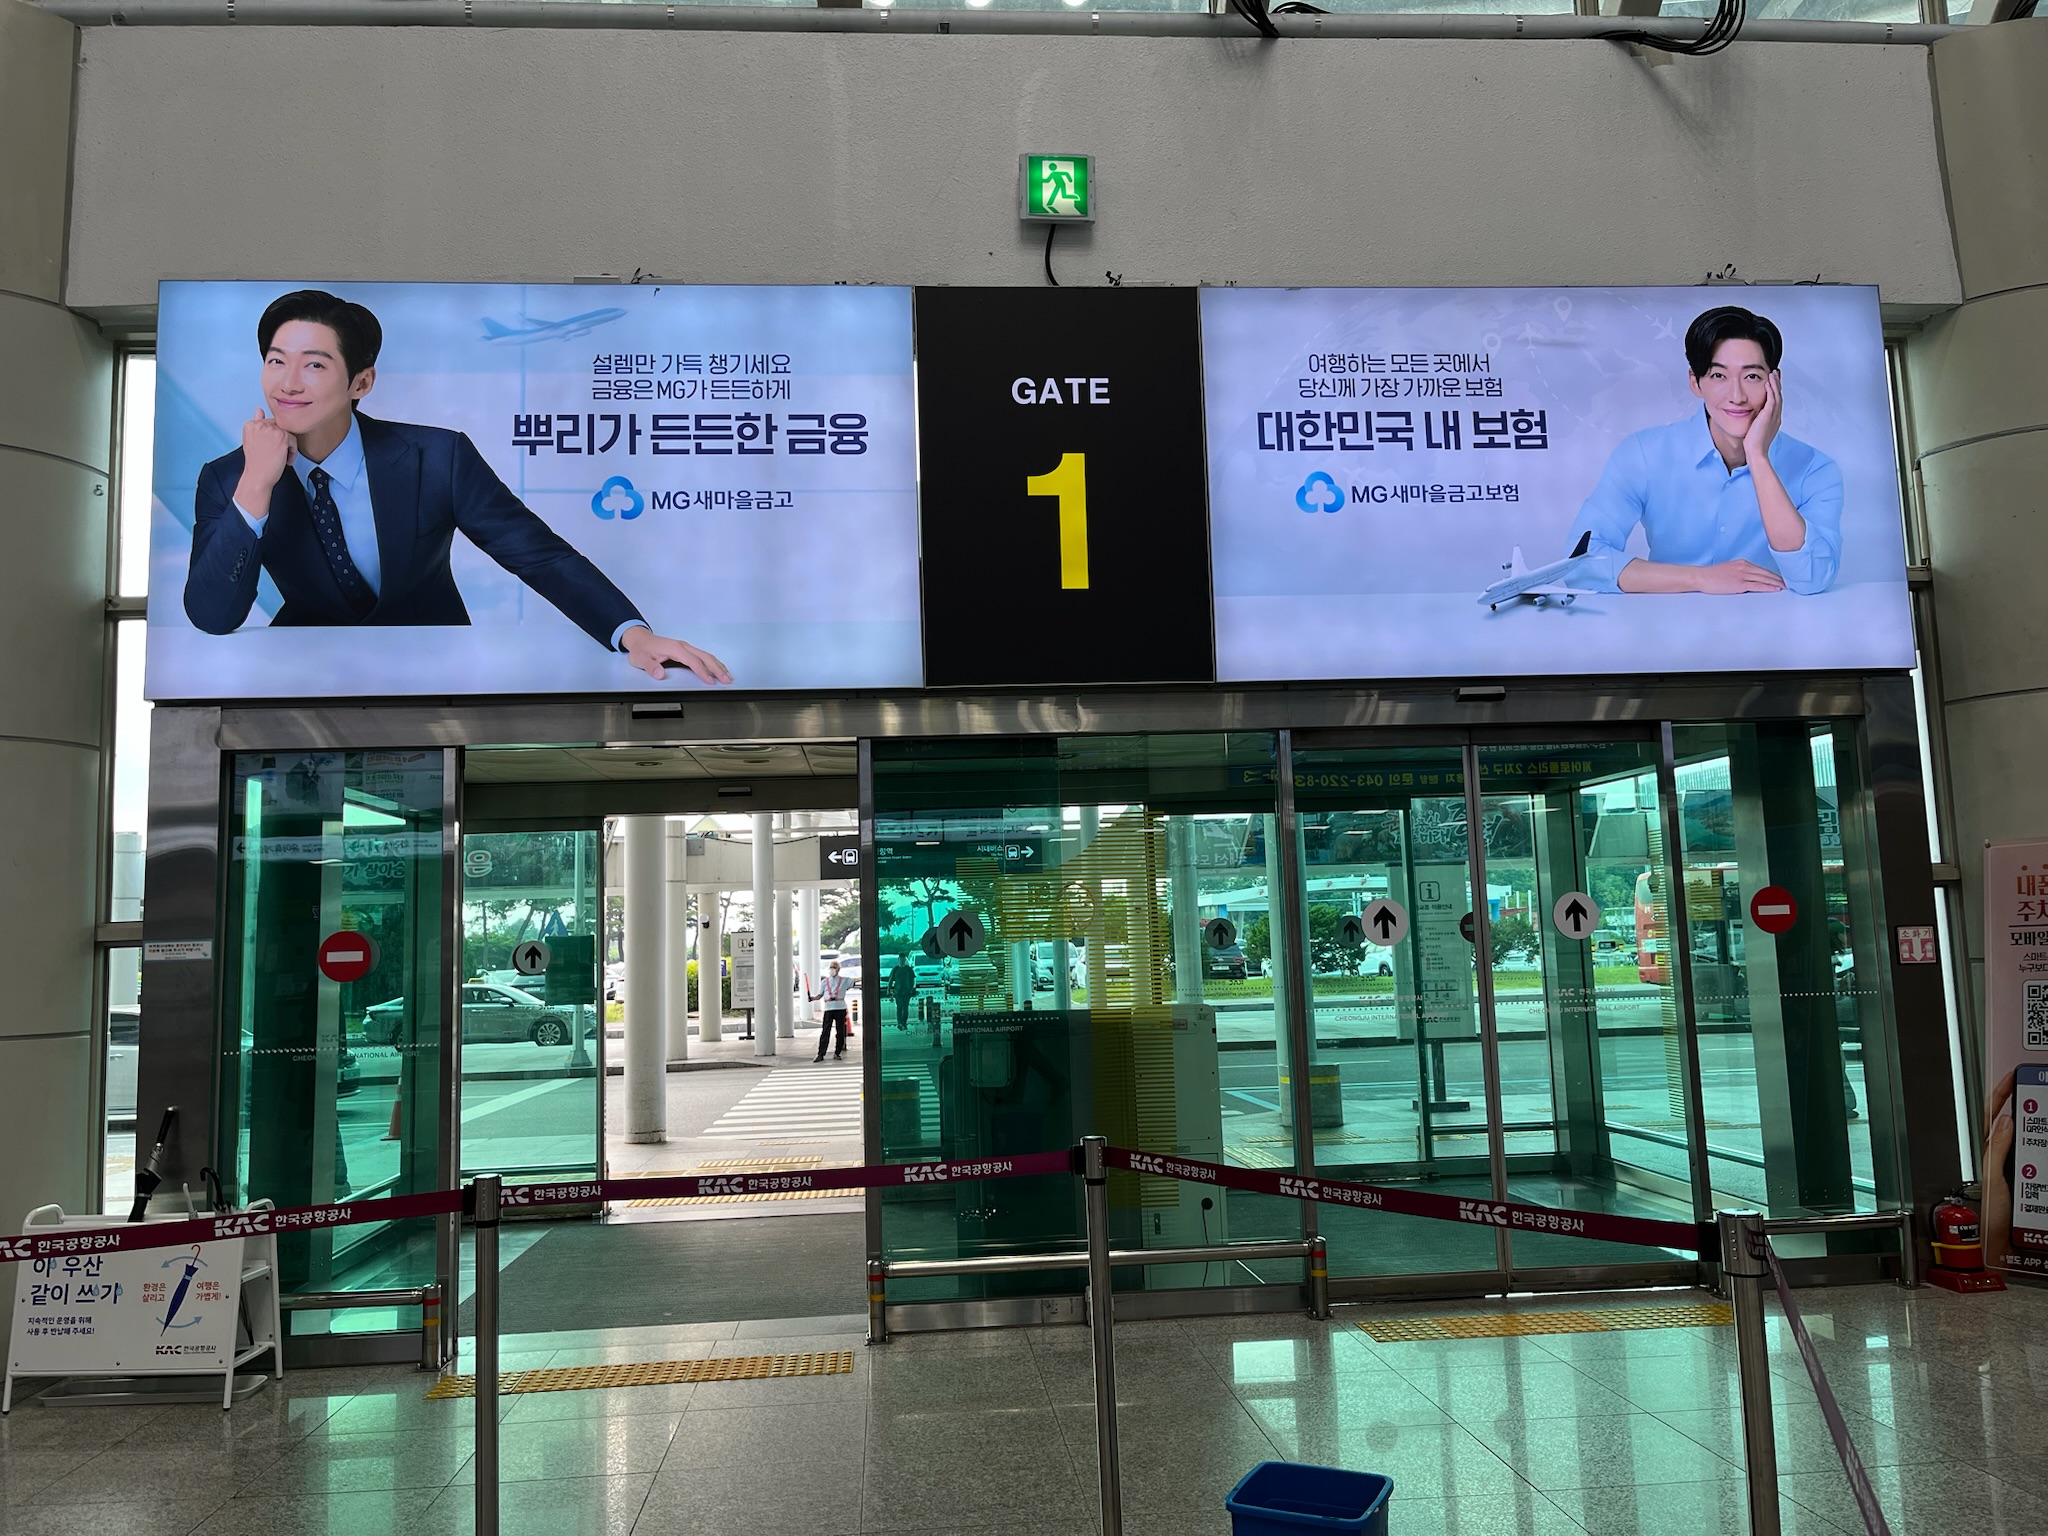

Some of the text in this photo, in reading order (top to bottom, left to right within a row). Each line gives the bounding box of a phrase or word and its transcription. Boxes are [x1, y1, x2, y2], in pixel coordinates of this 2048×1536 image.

[592, 354, 791, 375] 설렘만 가득 챙기세요
[1308, 352, 1491, 375] 여행하는 모든 곳에서
[592, 379, 791, 400] 금융은 MG가 든든하게
[1011, 377, 1110, 405] GATE
[1299, 376, 1503, 399] 당신께 가장 가까운 보험
[511, 412, 869, 456] 뿌리가 든든한 금융
[1257, 408, 1549, 451] 대한민국 내 보험
[1027, 453, 1089, 589] 1
[877, 847, 893, 856] 항역
[1902, 928, 1931, 938] 소화기
[1564, 1005, 1612, 1013] INTERNATIONAL
[943, 1026, 993, 1035] INTERNATIONAL
[995, 1025, 1024, 1033] AIRPORT
[2026, 1138, 2047, 1148] 주차장
[904, 1161, 1013, 1183] KAC 한국공항공사
[1130, 1152, 1217, 1182] KAC 한국공항공사
[501, 1185, 602, 1205] AC 한국공항공사
[697, 1175, 813, 1195] KAC 한국공항공사
[1279, 1177, 1382, 1205] KAC 한국공항공사
[2025, 1191, 2040, 1200] 입력
[214, 1207, 352, 1237] KAC 한국공항공사
[1458, 1201, 1585, 1233] KAC 한국공항공사
[0, 1234, 121, 1258] AC 한국공항공사
[62, 1255, 104, 1278] 우산
[2024, 1257, 2042, 1267] APP
[31, 1282, 119, 1306] 같이 쓰기
[143, 1281, 220, 1292] 환경은 여행은
[142, 1292, 222, 1303] 살리고 가볍게!
[28, 1316, 92, 1325] 지속적인 운영을 위해
[27, 1327, 95, 1336] 사용 후 반납해 주세요!
[155, 1345, 182, 1355] KAC
